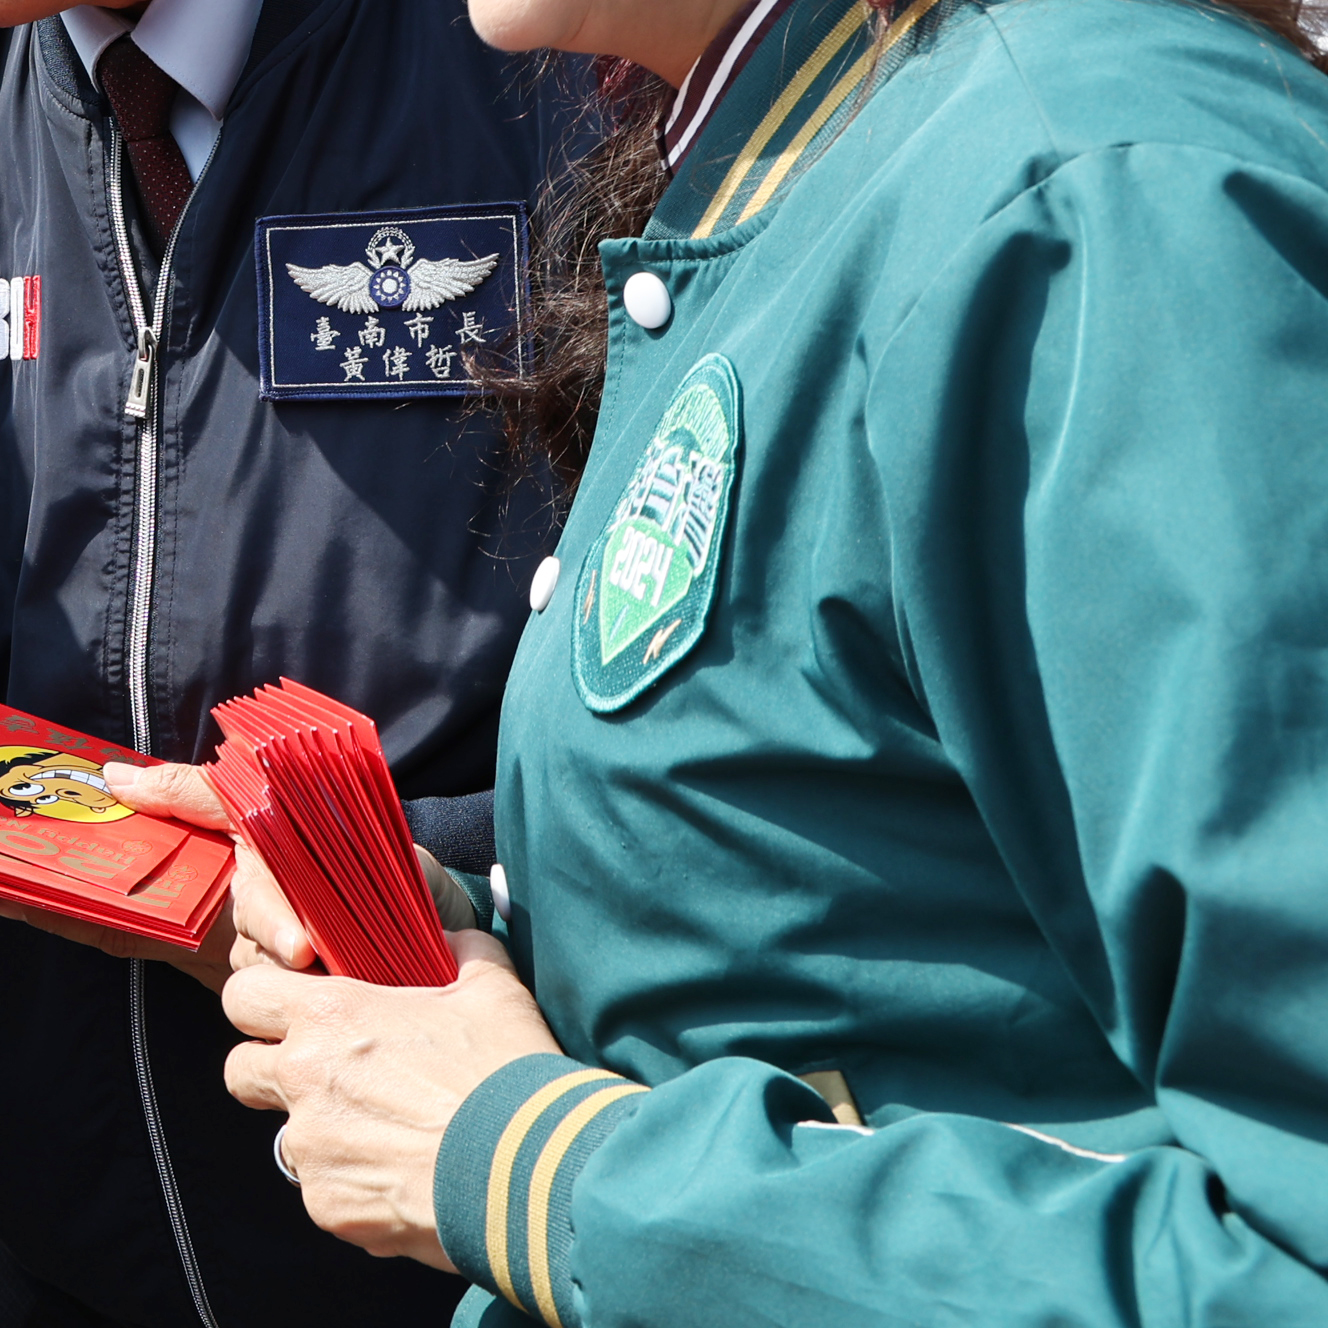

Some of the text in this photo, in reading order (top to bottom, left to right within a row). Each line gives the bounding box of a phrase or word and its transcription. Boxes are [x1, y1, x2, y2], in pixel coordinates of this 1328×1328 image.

[310, 311, 487, 352] 臺南市長
[340, 345, 458, 382] 黃偉哲
[609, 525, 675, 608] 2024
[35, 827, 135, 866] Happy
